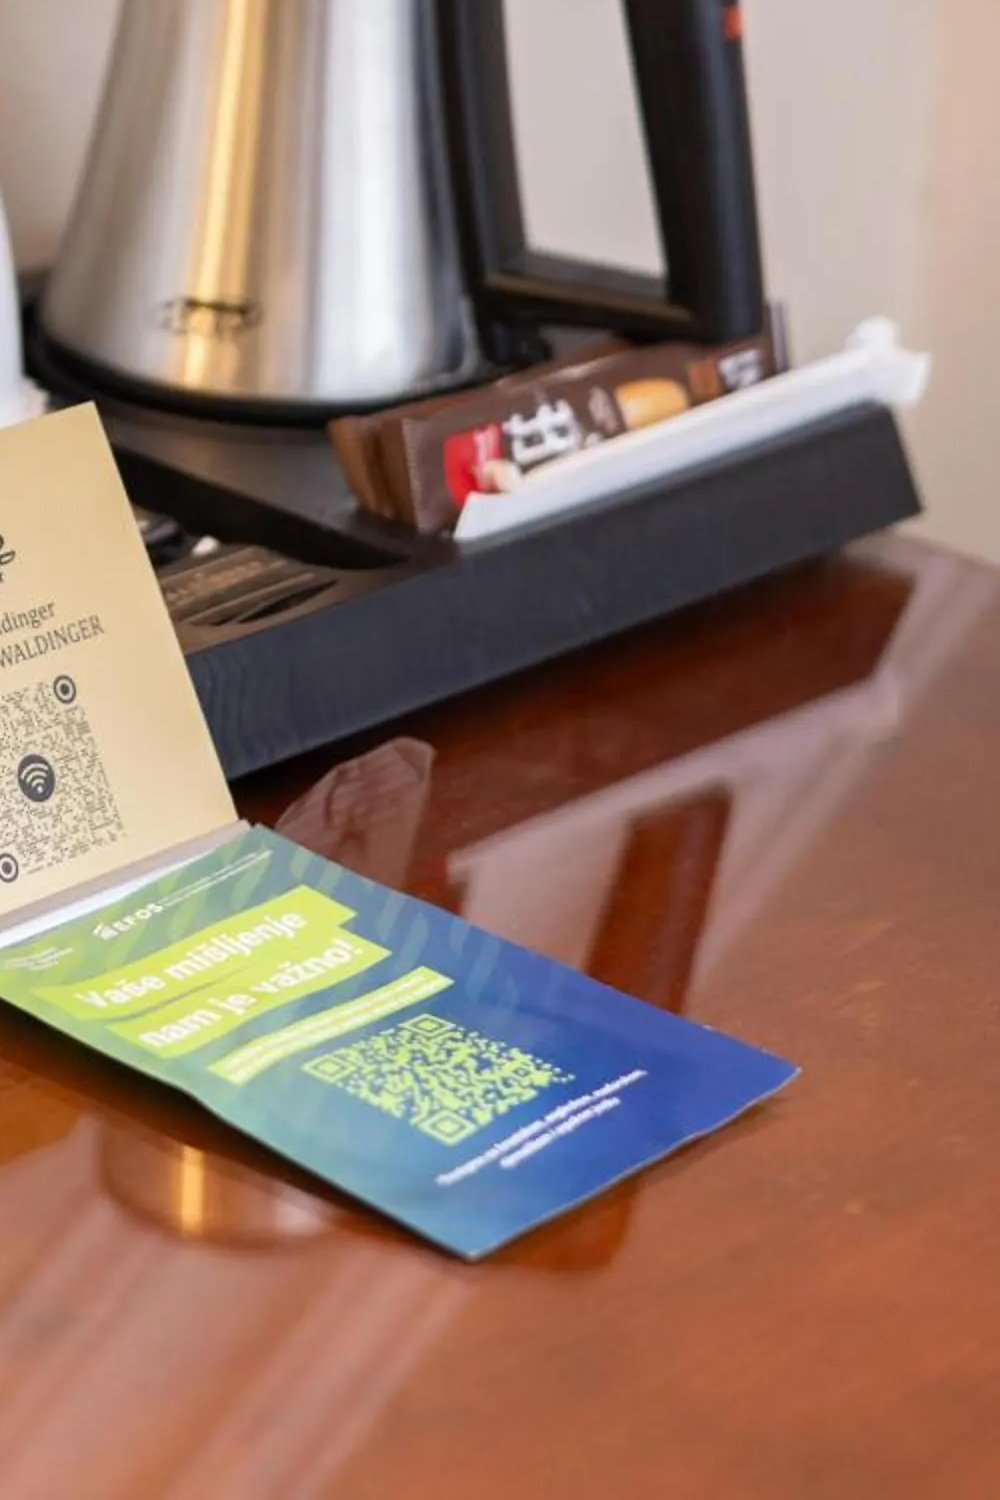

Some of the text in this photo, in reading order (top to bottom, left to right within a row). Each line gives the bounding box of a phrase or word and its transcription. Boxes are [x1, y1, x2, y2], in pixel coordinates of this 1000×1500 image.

[76, 910, 308, 1011] Vaše mišljenje
[139, 1007, 222, 1049] nam
[209, 990, 258, 1016] je
[250, 937, 363, 997] važno!
